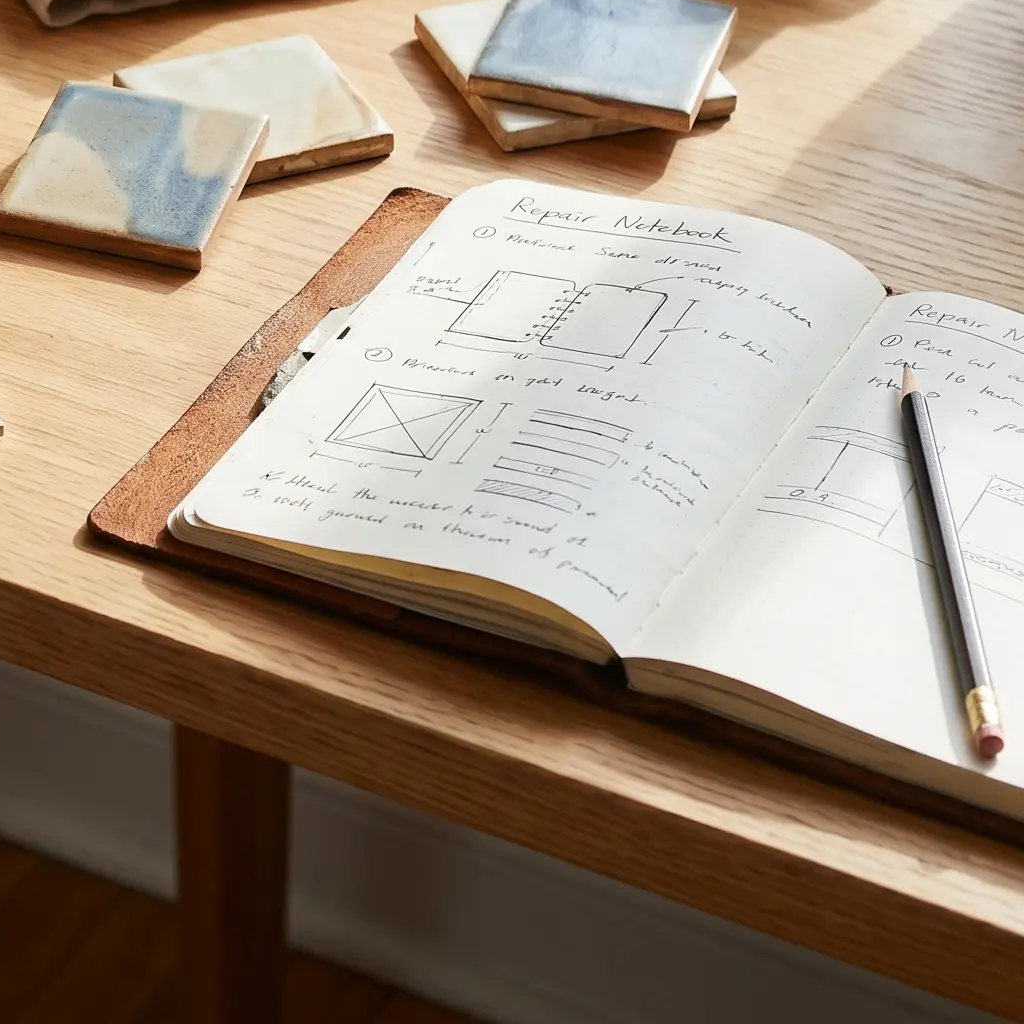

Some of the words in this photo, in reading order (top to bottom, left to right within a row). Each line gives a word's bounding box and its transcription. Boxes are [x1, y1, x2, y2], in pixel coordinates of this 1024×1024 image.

[511, 196, 598, 224] Repair
[613, 215, 732, 243] Notebook
[909, 303, 991, 325] Repair
